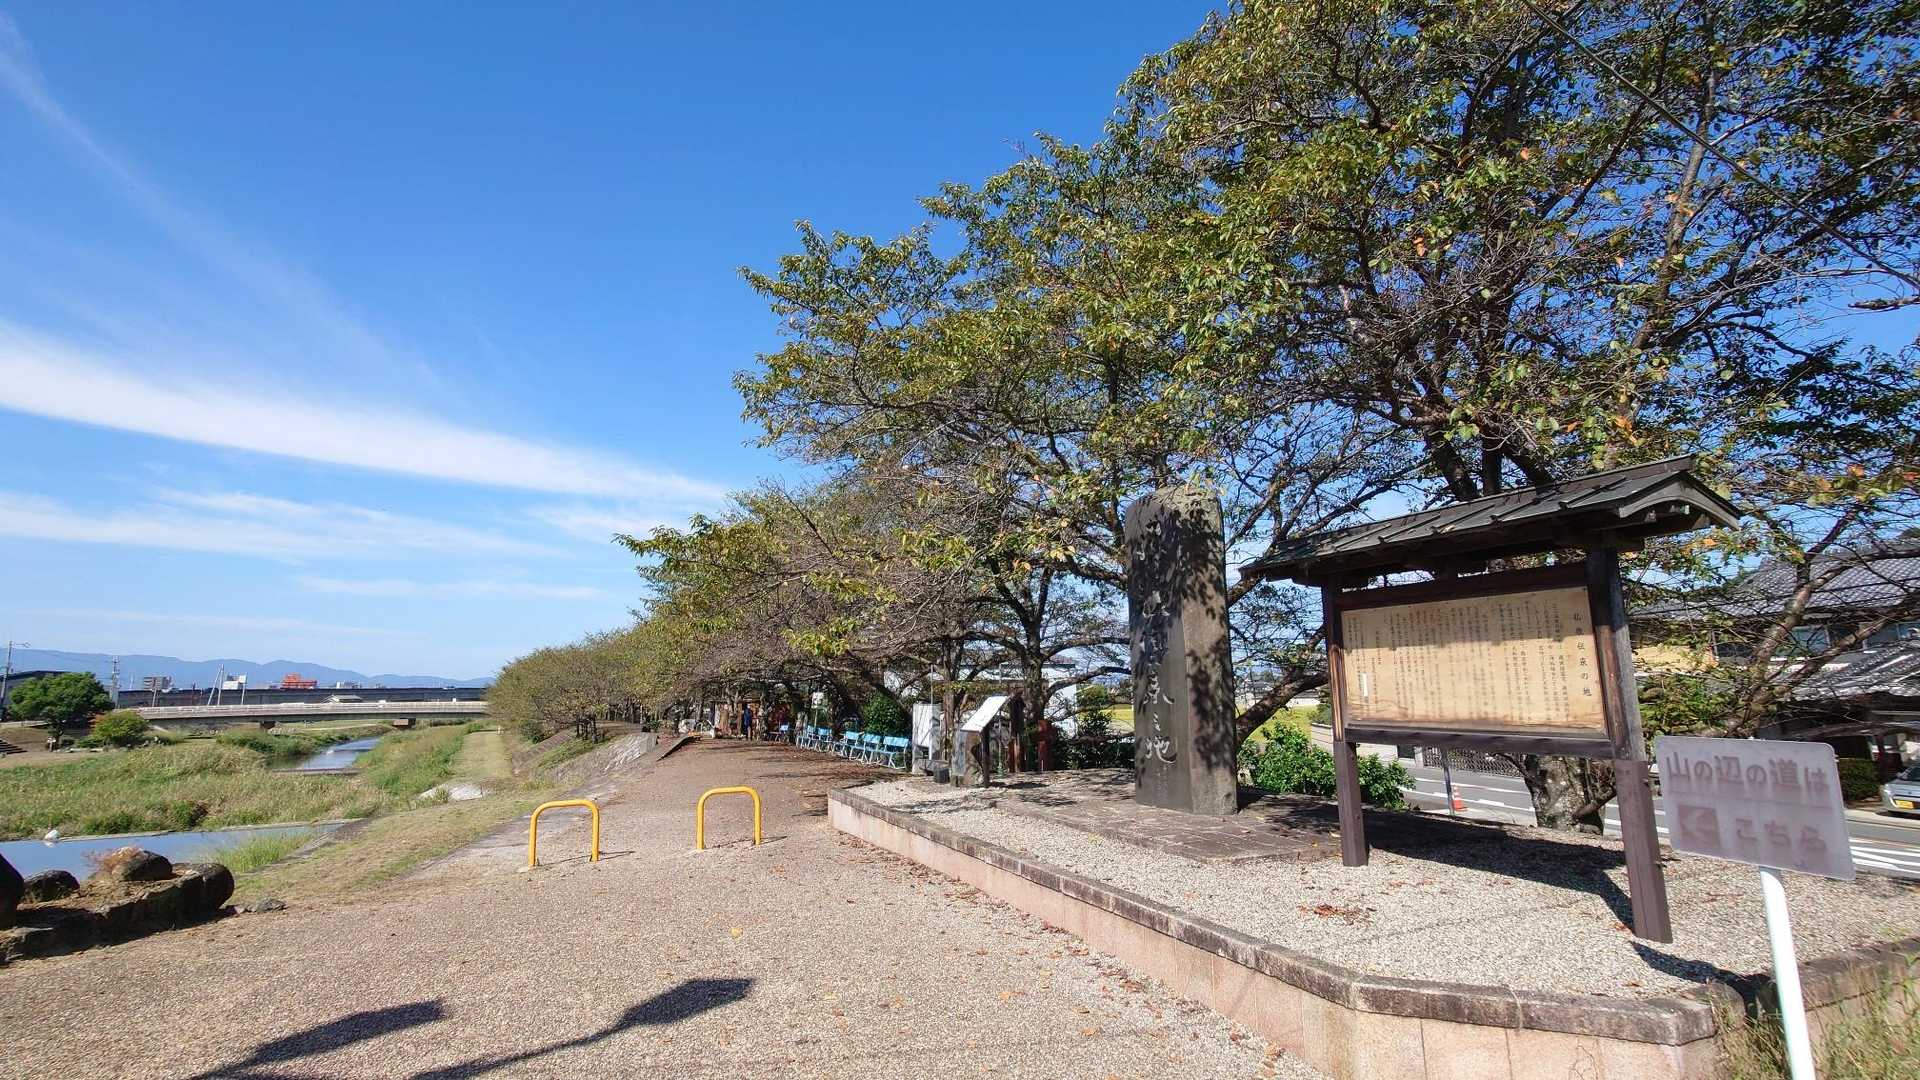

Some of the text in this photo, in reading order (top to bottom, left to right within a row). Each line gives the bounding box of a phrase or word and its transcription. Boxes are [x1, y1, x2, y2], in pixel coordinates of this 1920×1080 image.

[1665, 751, 1831, 793] 山の辺の道は
[1735, 817, 1828, 850] こちら
